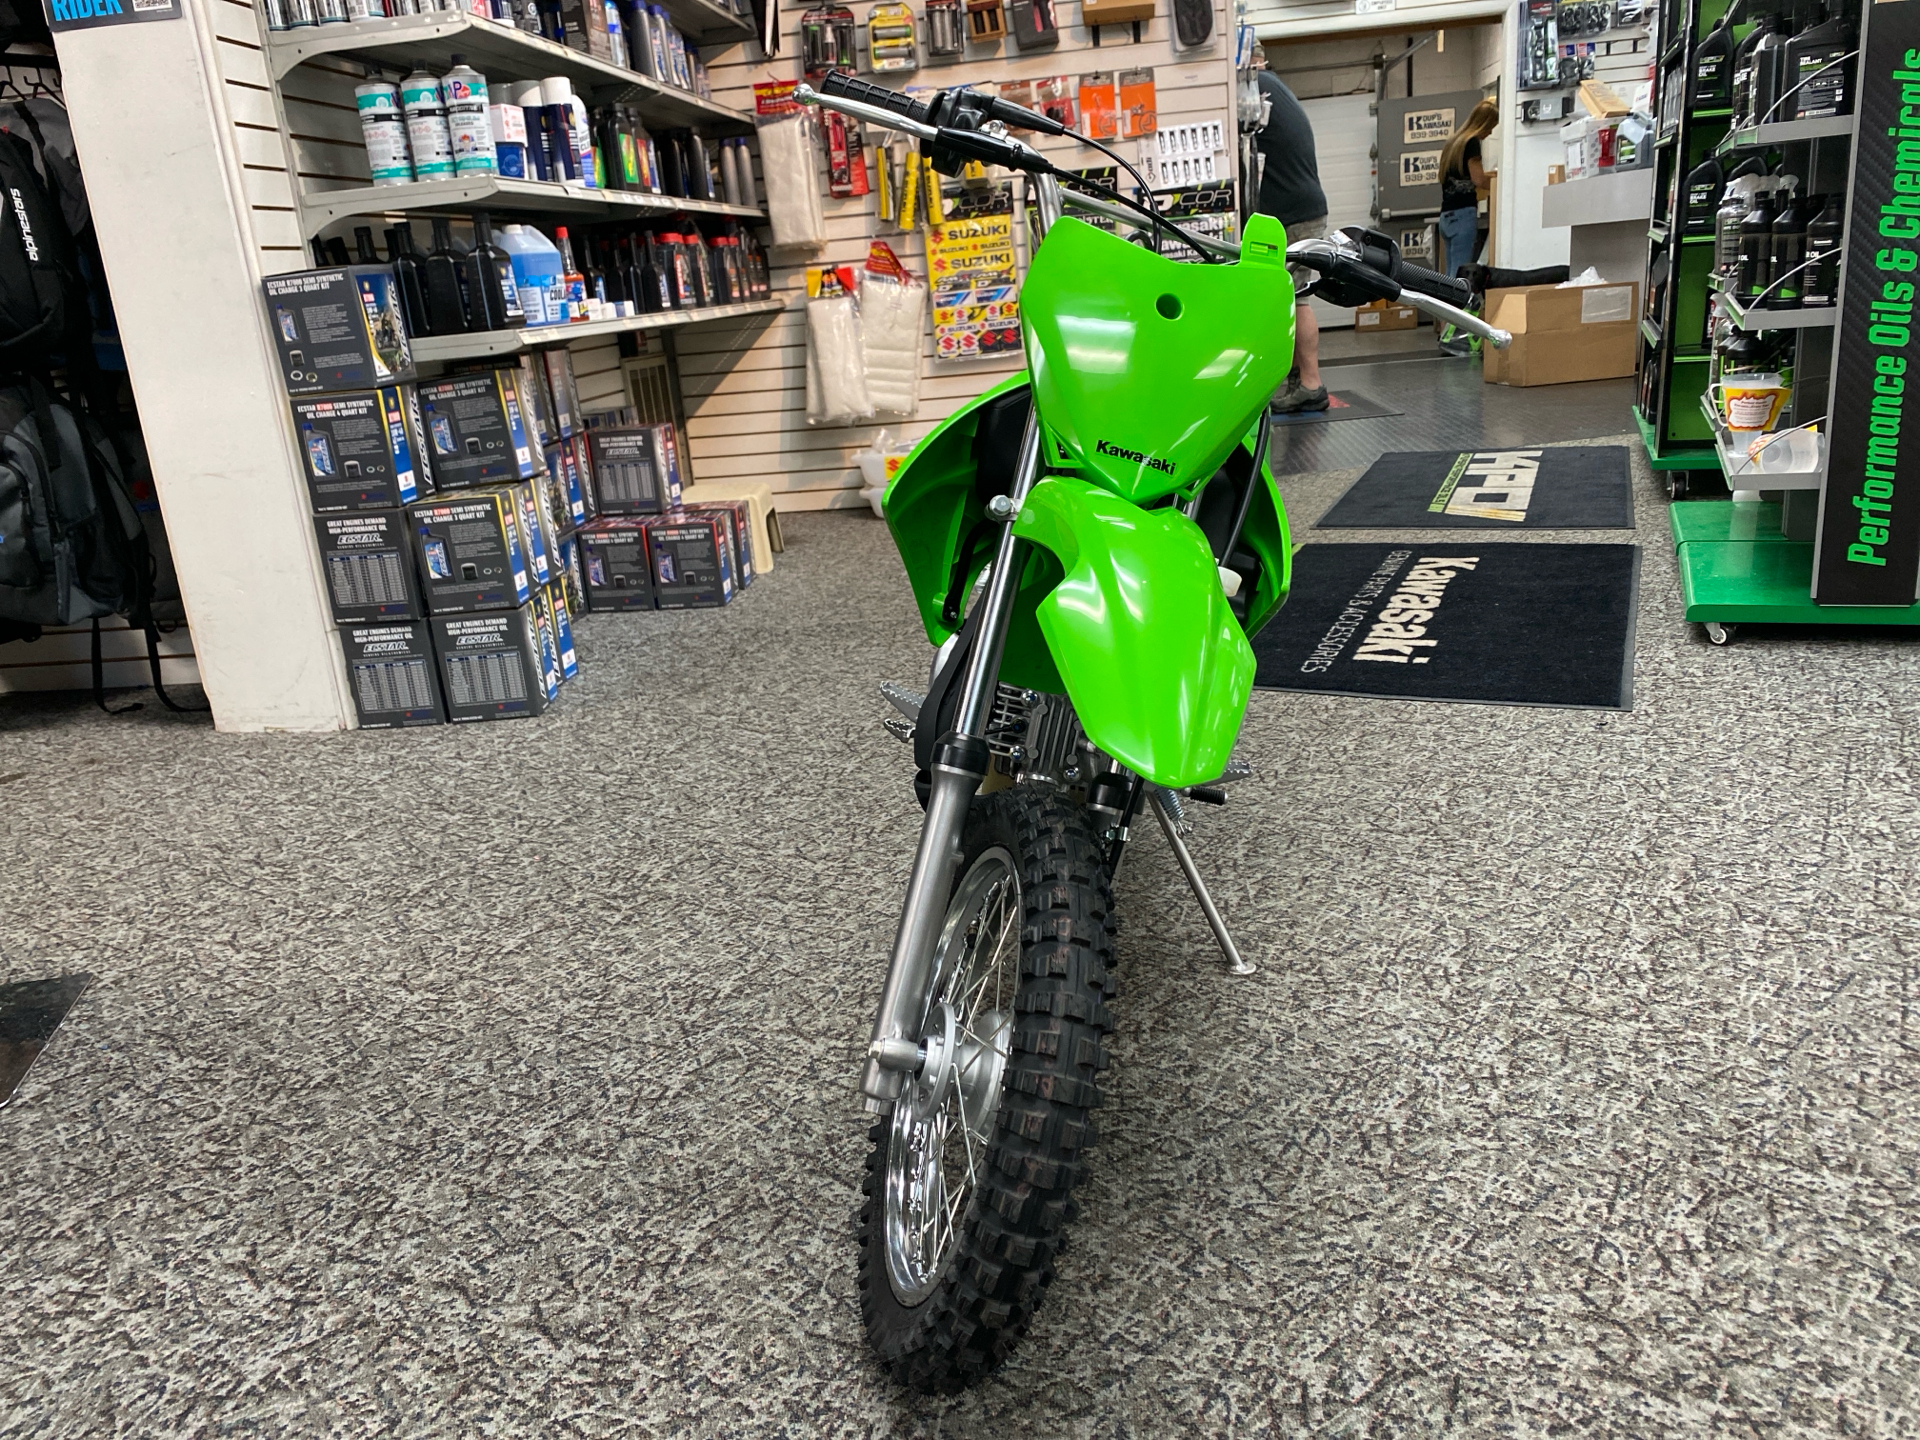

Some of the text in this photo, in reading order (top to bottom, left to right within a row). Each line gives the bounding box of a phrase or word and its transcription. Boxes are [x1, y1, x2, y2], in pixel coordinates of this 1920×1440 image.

[10, 188, 39, 262] alpinestars
[948, 225, 1008, 241] SUZUKI
[980, 240, 1010, 249] SUZUKI
[951, 253, 1010, 269] SUZUKI
[1876, 247, 1918, 272] &
[267, 280, 286, 289] ECSTAR
[302, 276, 316, 285] SEMI
[316, 273, 344, 284] SYNTHETIC
[269, 288, 277, 296] OIL
[278, 286, 299, 295] CHANGE
[304, 283, 321, 292] QUART
[321, 282, 330, 290] KIT
[1868, 280, 1915, 348] Oils
[297, 404, 316, 412] ECSTAR
[333, 401, 347, 409] SEMI
[346, 399, 374, 408] SYNTHETIC
[307, 411, 315, 419] OIL
[316, 410, 336, 418] CHANGE
[341, 408, 358, 417] QUART
[359, 407, 368, 415] KIT
[1096, 440, 1177, 475] Kawasaki
[1847, 354, 1908, 567] Performance
[414, 510, 433, 518] ECSTAR
[451, 506, 464, 514] SEMI
[464, 503, 491, 513] SYNTHETIC
[424, 516, 433, 524] OIL
[433, 515, 453, 523] CHANGE
[459, 512, 475, 521] QUART
[476, 511, 485, 519] KIT
[343, 518, 364, 526] ENGINES
[364, 517, 387, 525] DEMAND
[337, 533, 383, 545] ECSTAR
[1354, 577, 1392, 598] PARTS
[1352, 557, 1480, 664] Kawasaki
[447, 625, 499, 635] HIGH-PERFORMANCE
[456, 633, 504, 645] ECSTAR
[1301, 606, 1369, 673] ACCESSORIES
[363, 641, 409, 653] ECSTAR
